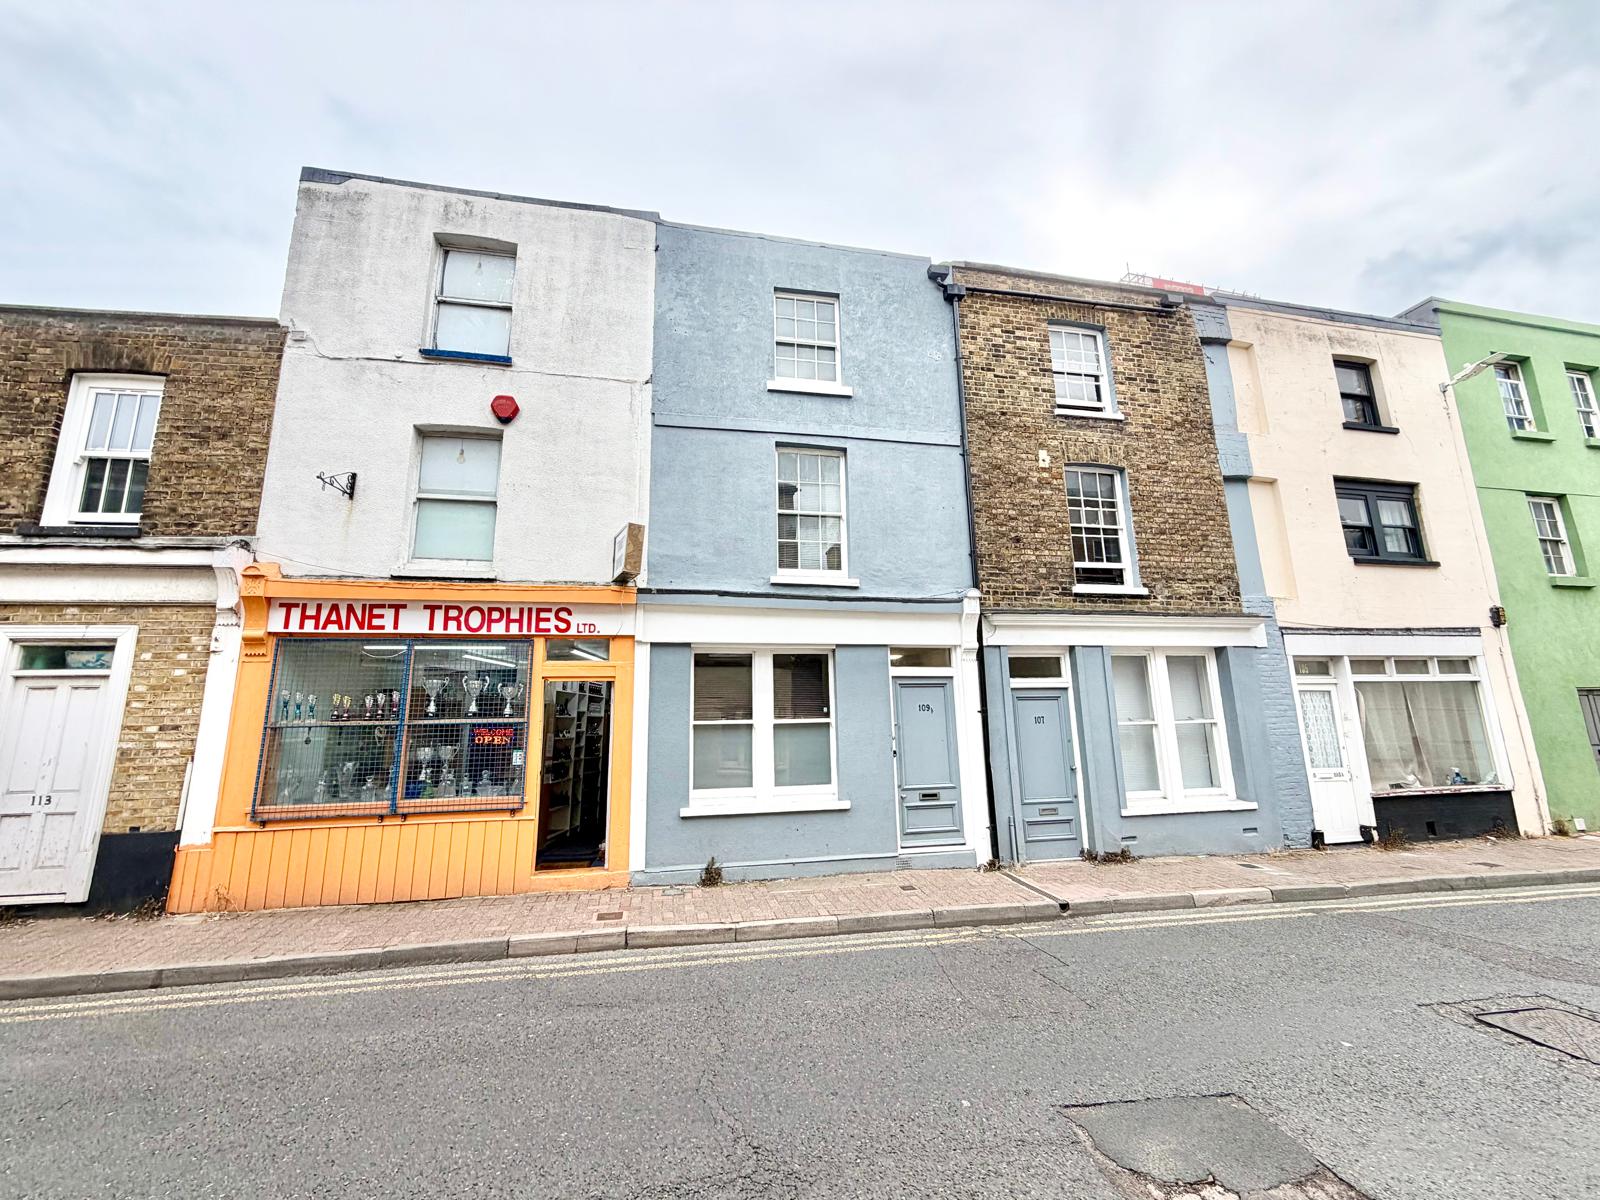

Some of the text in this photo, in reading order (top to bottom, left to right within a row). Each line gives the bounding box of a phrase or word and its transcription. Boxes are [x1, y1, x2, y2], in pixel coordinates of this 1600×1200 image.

[278, 602, 600, 634] THANET TROPHIES LTD.
[1034, 715, 1045, 725] 107
[473, 728, 513, 736] WELCOME
[474, 736, 511, 745] OPEN
[31, 795, 52, 806] 113
